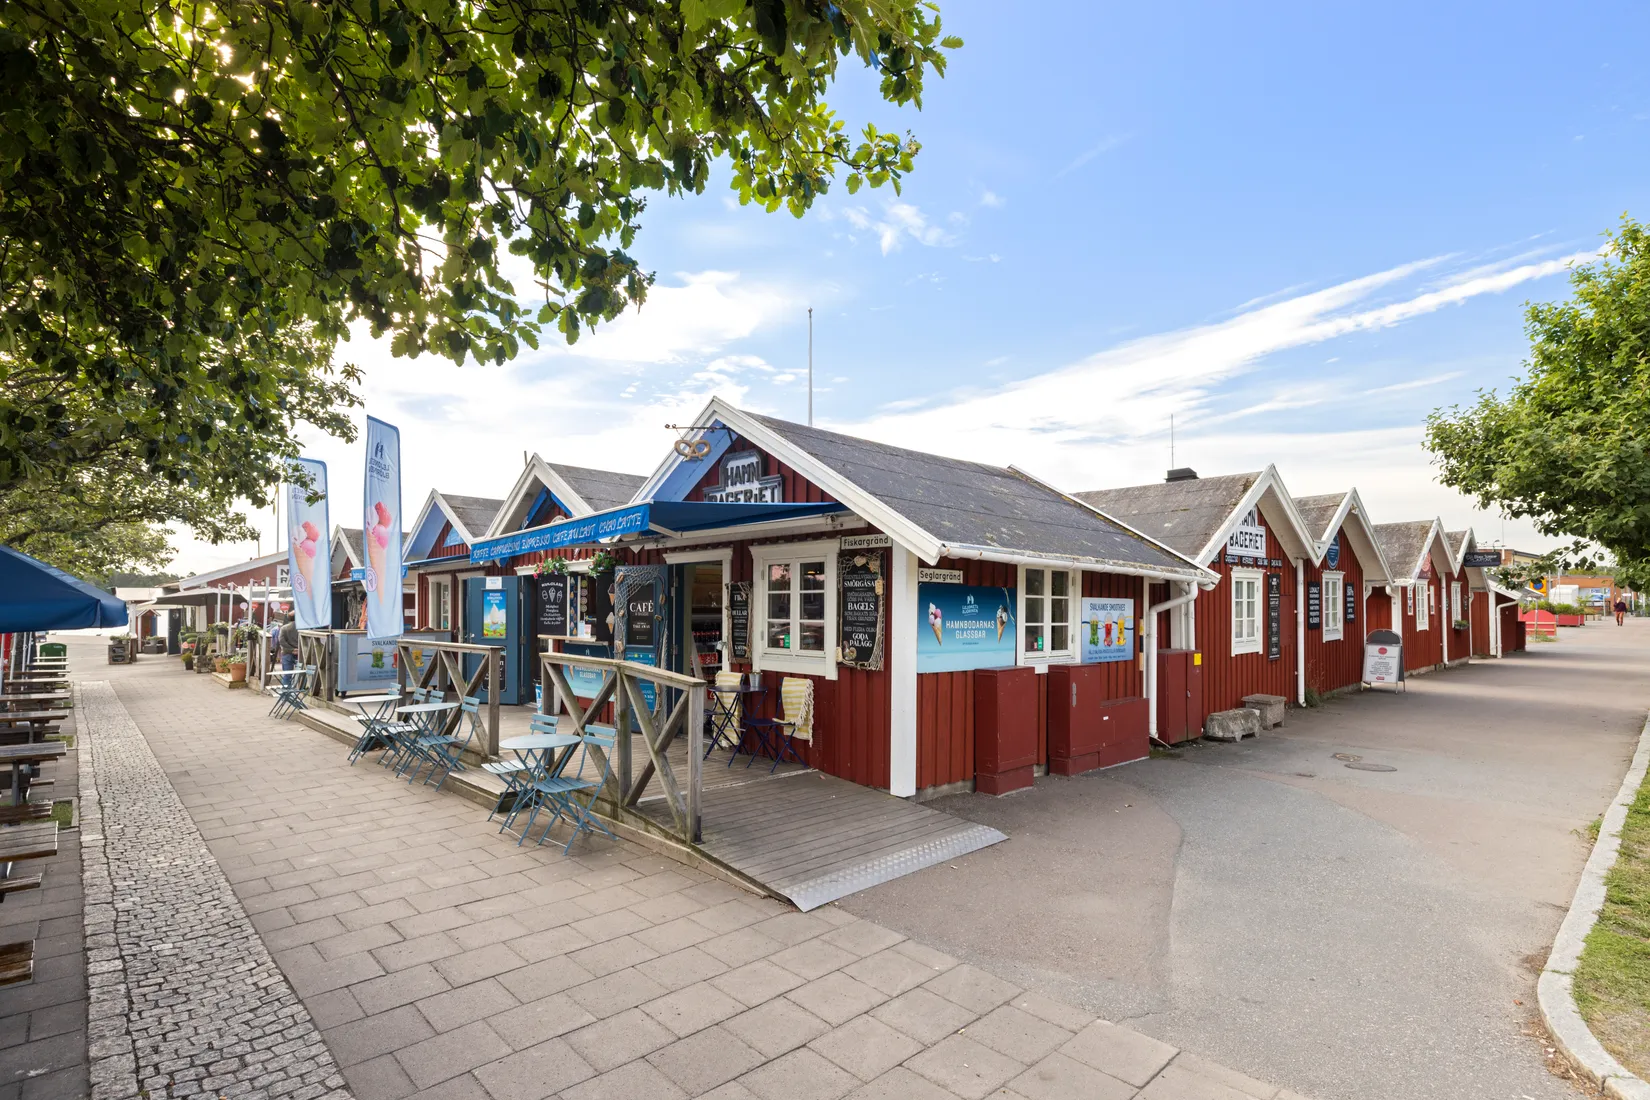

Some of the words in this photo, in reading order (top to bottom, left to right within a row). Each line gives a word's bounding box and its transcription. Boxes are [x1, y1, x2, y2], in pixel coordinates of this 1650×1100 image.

[725, 461, 760, 487] HAMN
[1240, 509, 1256, 527] AMN
[473, 548, 489, 558] KAFFE
[522, 533, 550, 549] ESPRESSO
[616, 512, 642, 530] LATTE
[843, 535, 889, 546] Fiskargränd
[920, 571, 961, 581] Seglargränd
[847, 602, 875, 611] BAGELS
[945, 620, 995, 629] HAMNBODARNAS
[852, 632, 869, 641] GODA
[955, 630, 986, 639] GLASSBAR
[849, 639, 872, 647] PÅLÄGG
